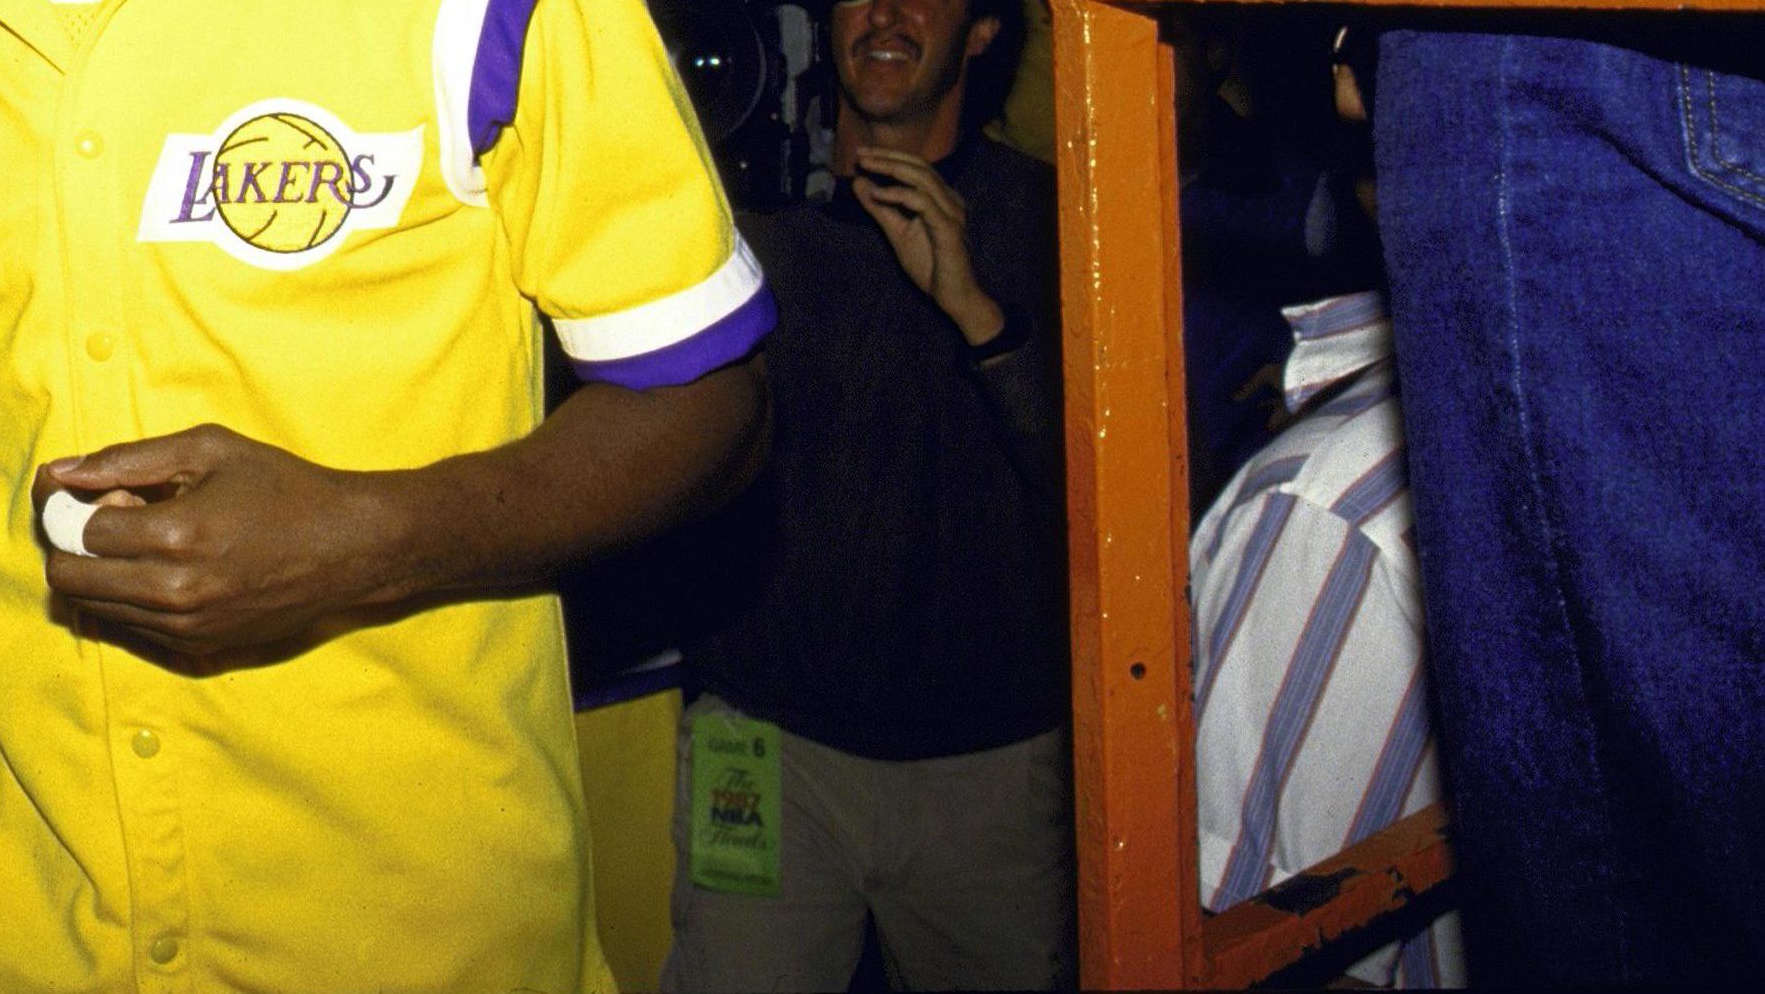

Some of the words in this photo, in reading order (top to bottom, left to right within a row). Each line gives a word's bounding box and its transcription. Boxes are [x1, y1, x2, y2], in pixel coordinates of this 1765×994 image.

[169, 150, 398, 224] LAKERS
[752, 737, 766, 758] 6
[711, 807, 763, 827] NBA
